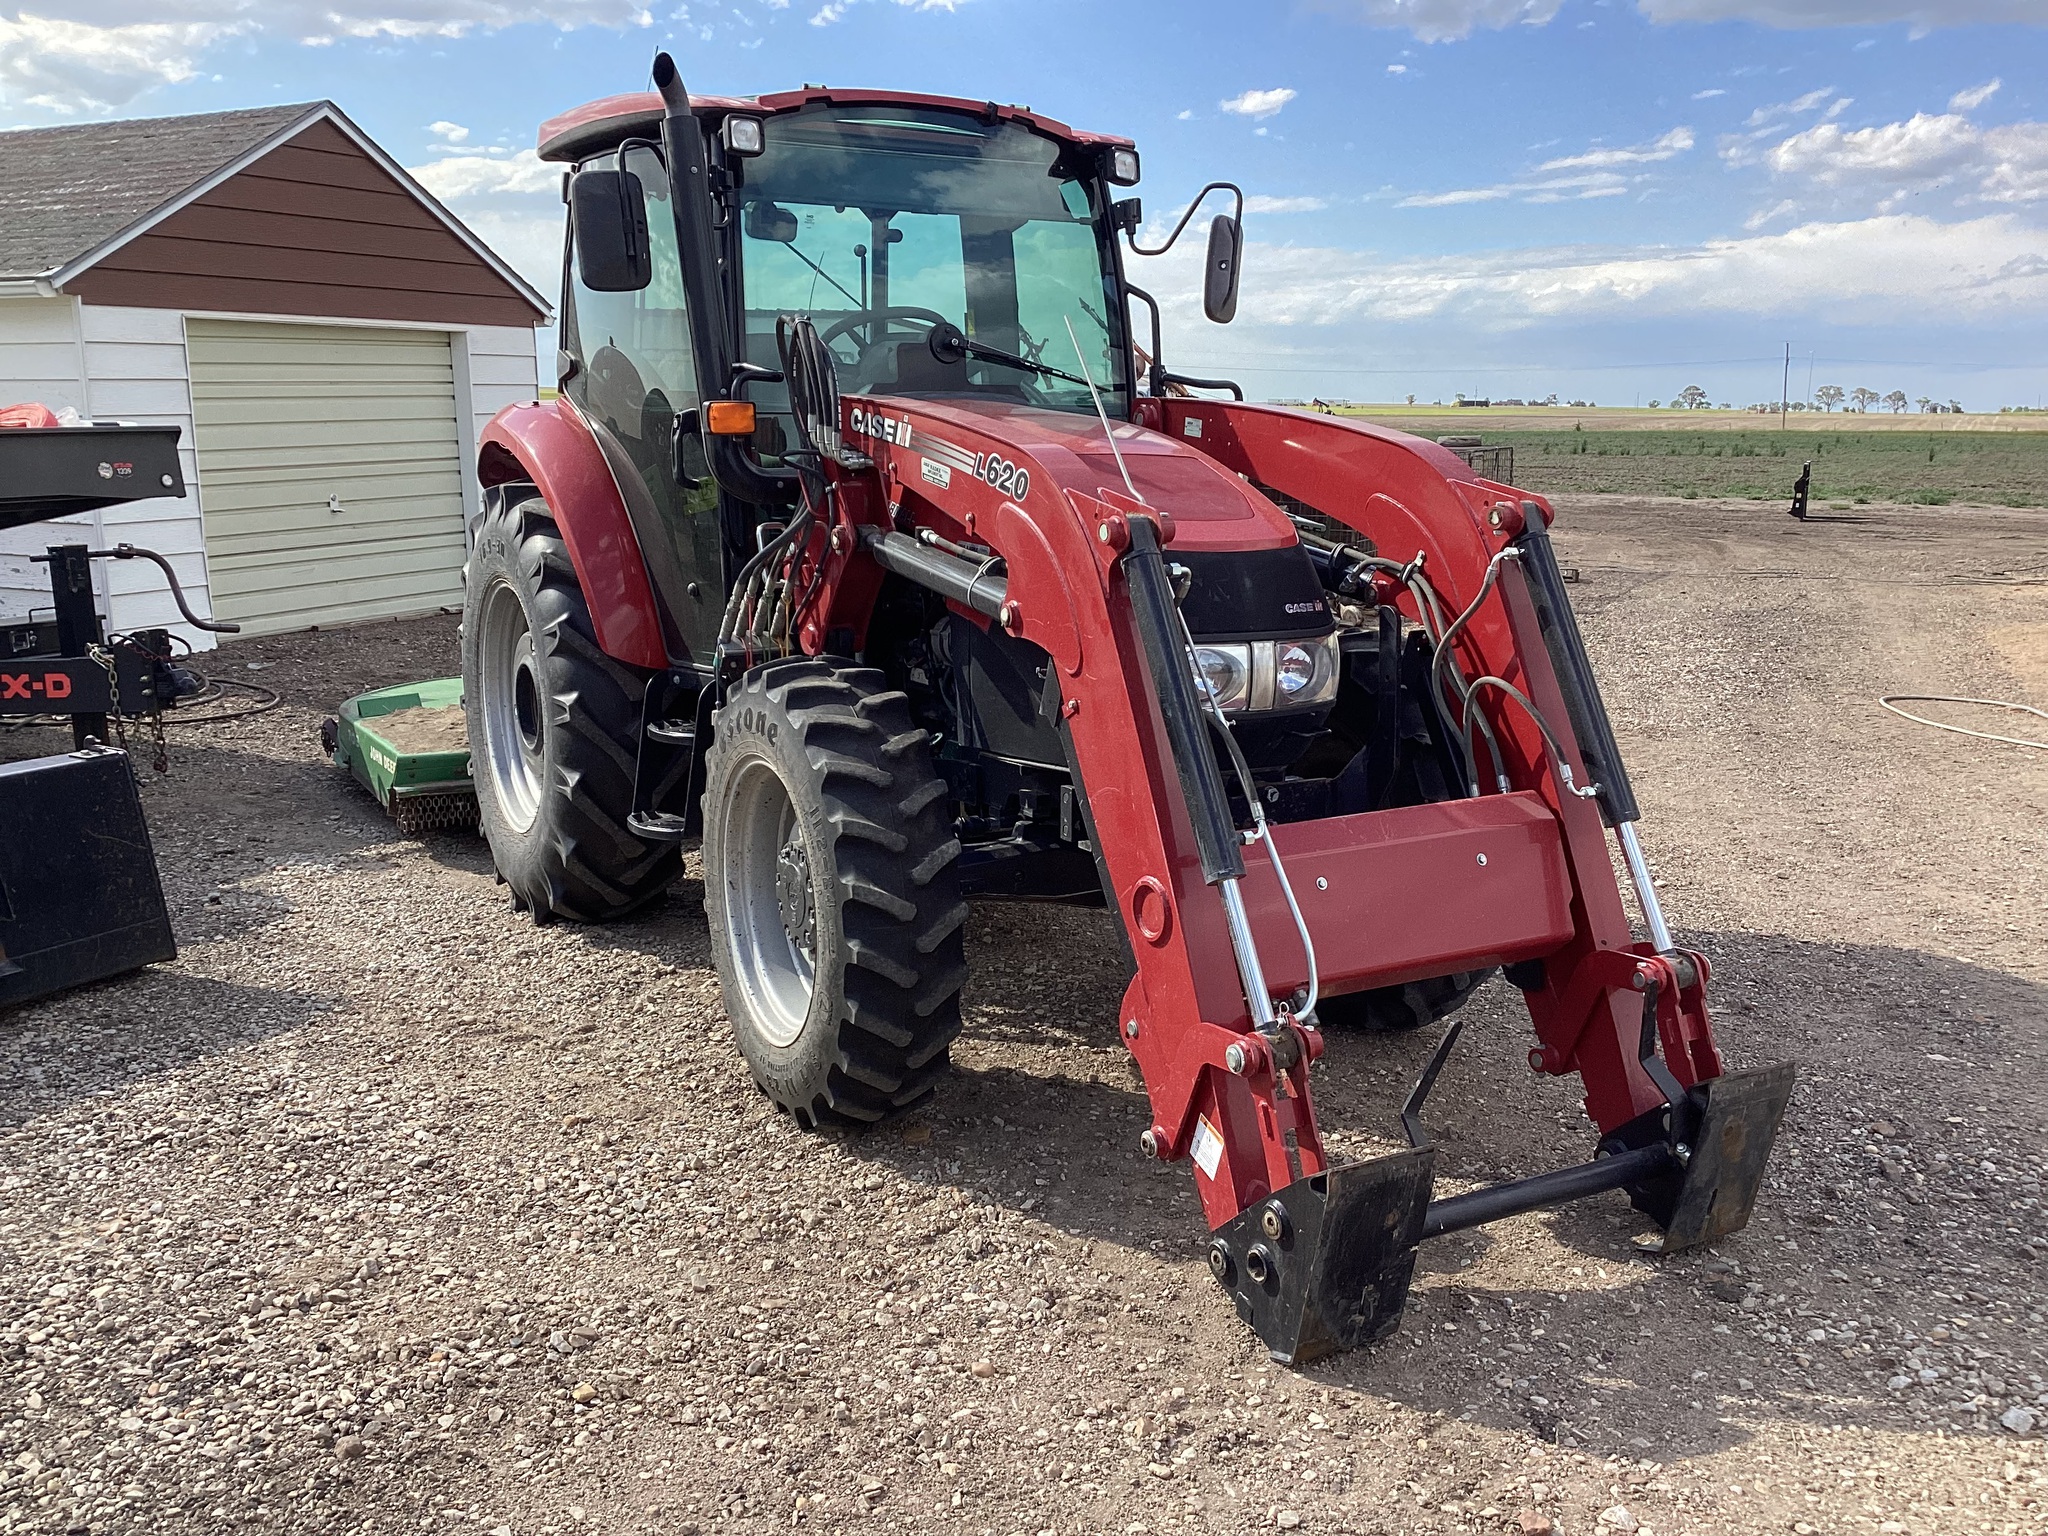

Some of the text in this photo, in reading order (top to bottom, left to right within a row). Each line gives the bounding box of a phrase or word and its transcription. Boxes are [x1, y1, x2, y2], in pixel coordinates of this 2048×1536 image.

[850, 408, 896, 443] CASE
[974, 452, 1030, 502] L620
[1285, 603, 1314, 614] CASE
[0, 673, 72, 699] X-D
